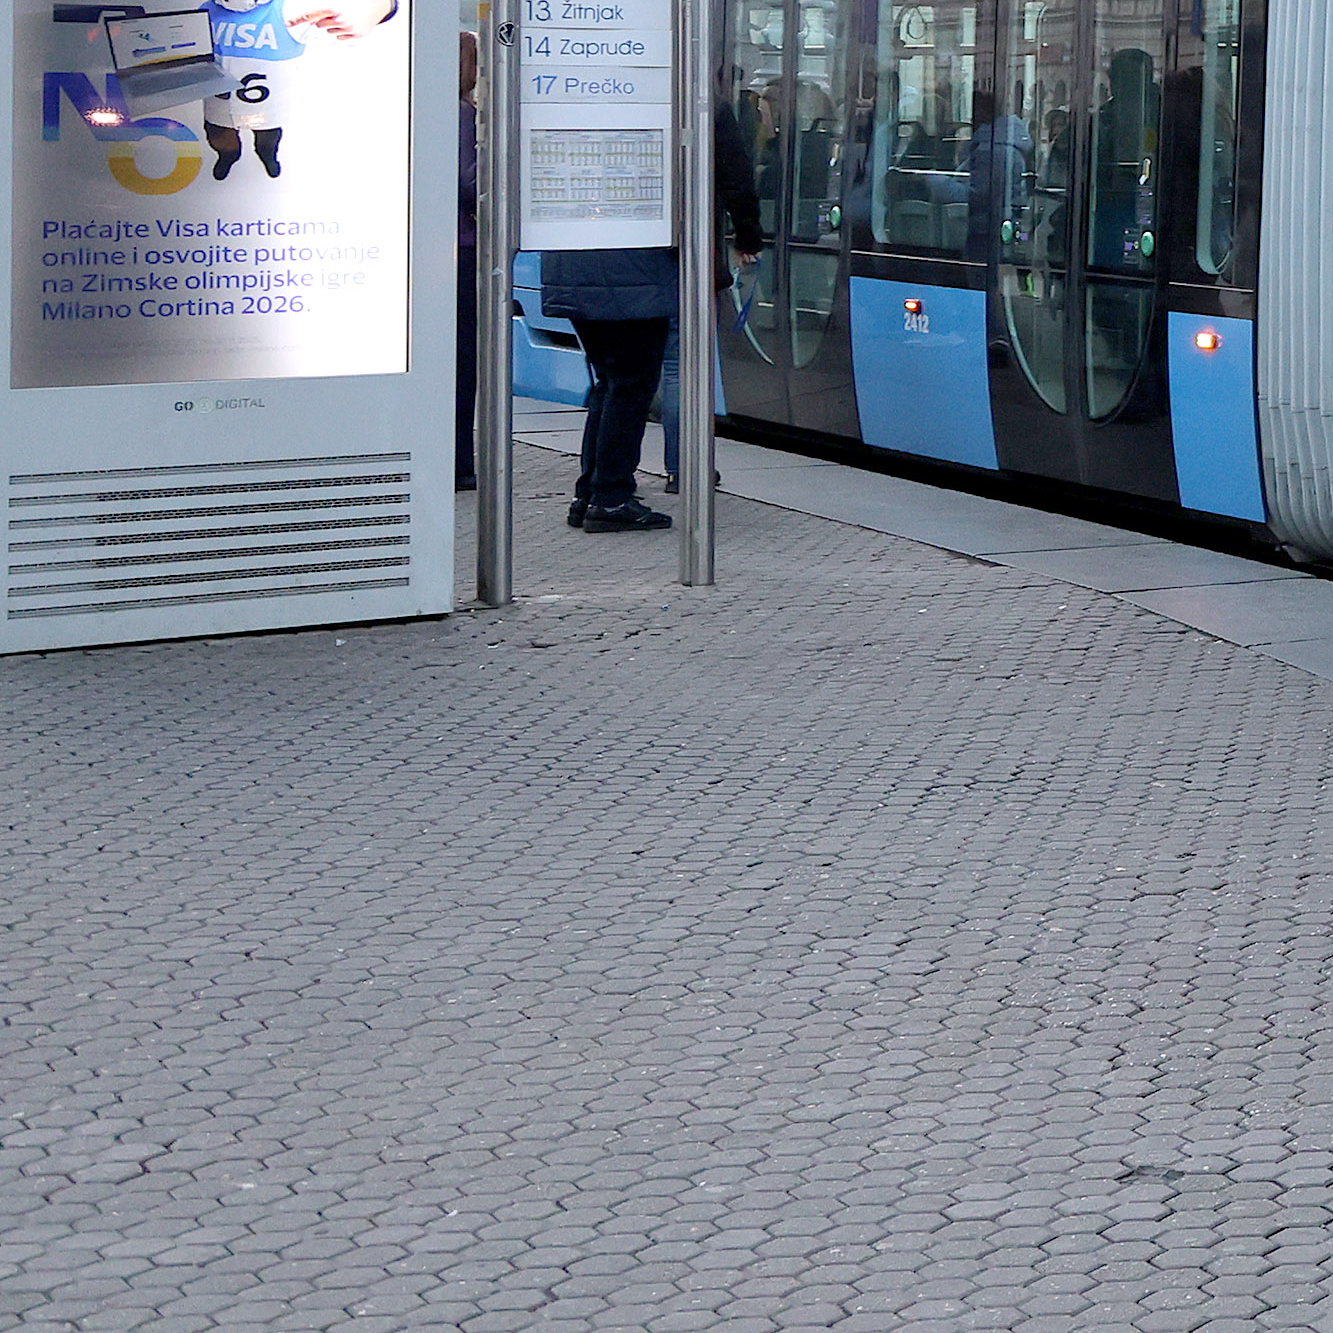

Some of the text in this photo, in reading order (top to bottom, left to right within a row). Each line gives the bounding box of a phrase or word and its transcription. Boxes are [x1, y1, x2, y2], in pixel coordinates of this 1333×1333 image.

[525, 0, 552, 22] 13
[213, 23, 278, 50] VISA
[524, 36, 645, 59] 14 Zapruđe
[532, 75, 635, 96] 17 Prečko
[42, 218, 340, 242] Plaćajte Visa karticama
[42, 241, 381, 268] online i osvojite putovanje
[42, 269, 367, 293] na Zimske olimpijske igre
[42, 295, 311, 321] Milano Cortina 2026.
[904, 312, 930, 334] 2412
[174, 401, 194, 412] GO
[215, 398, 265, 410] DIGITAL
